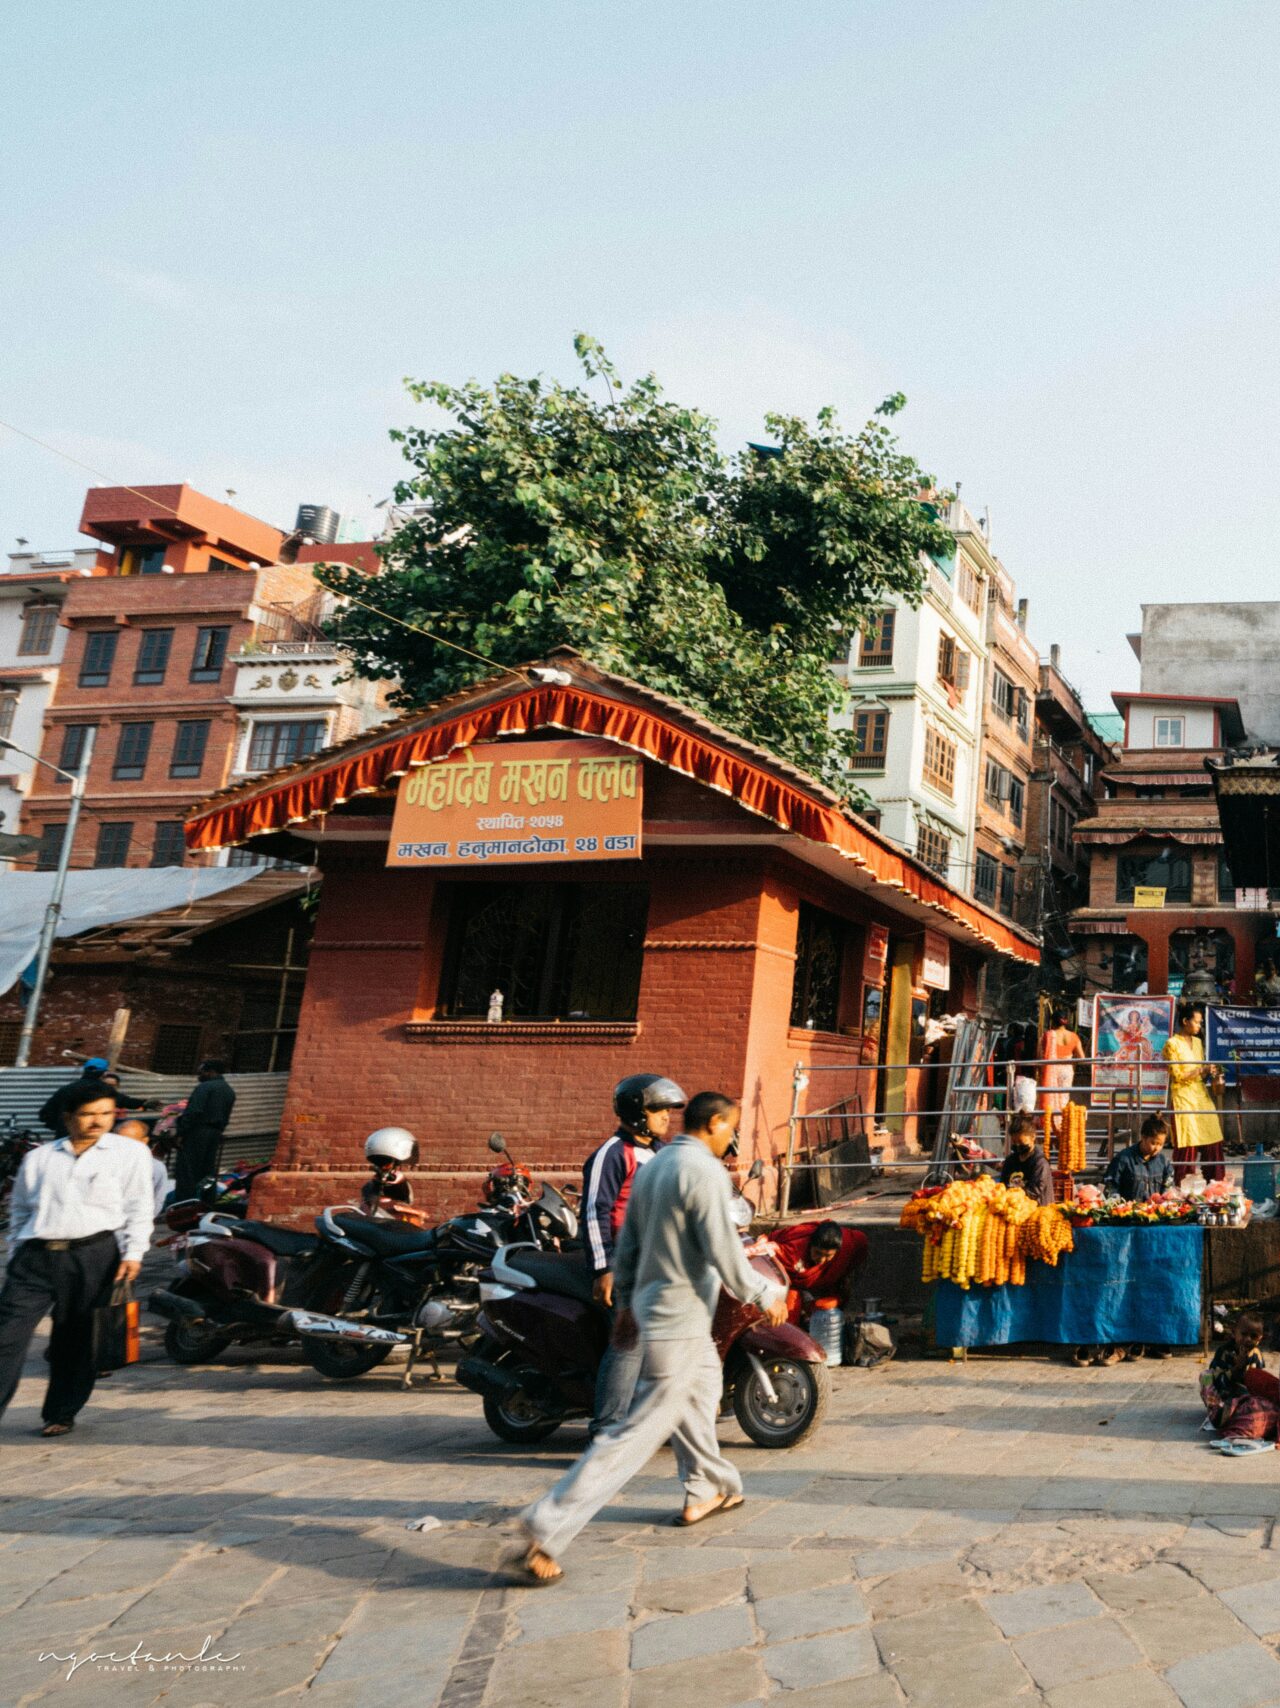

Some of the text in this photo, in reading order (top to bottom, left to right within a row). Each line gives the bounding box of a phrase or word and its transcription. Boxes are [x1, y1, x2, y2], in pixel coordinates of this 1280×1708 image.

[499, 758, 572, 806] मखन
[476, 812, 525, 831] स्थापित
[576, 837, 598, 851] २४
[603, 834, 637, 851] वडा
